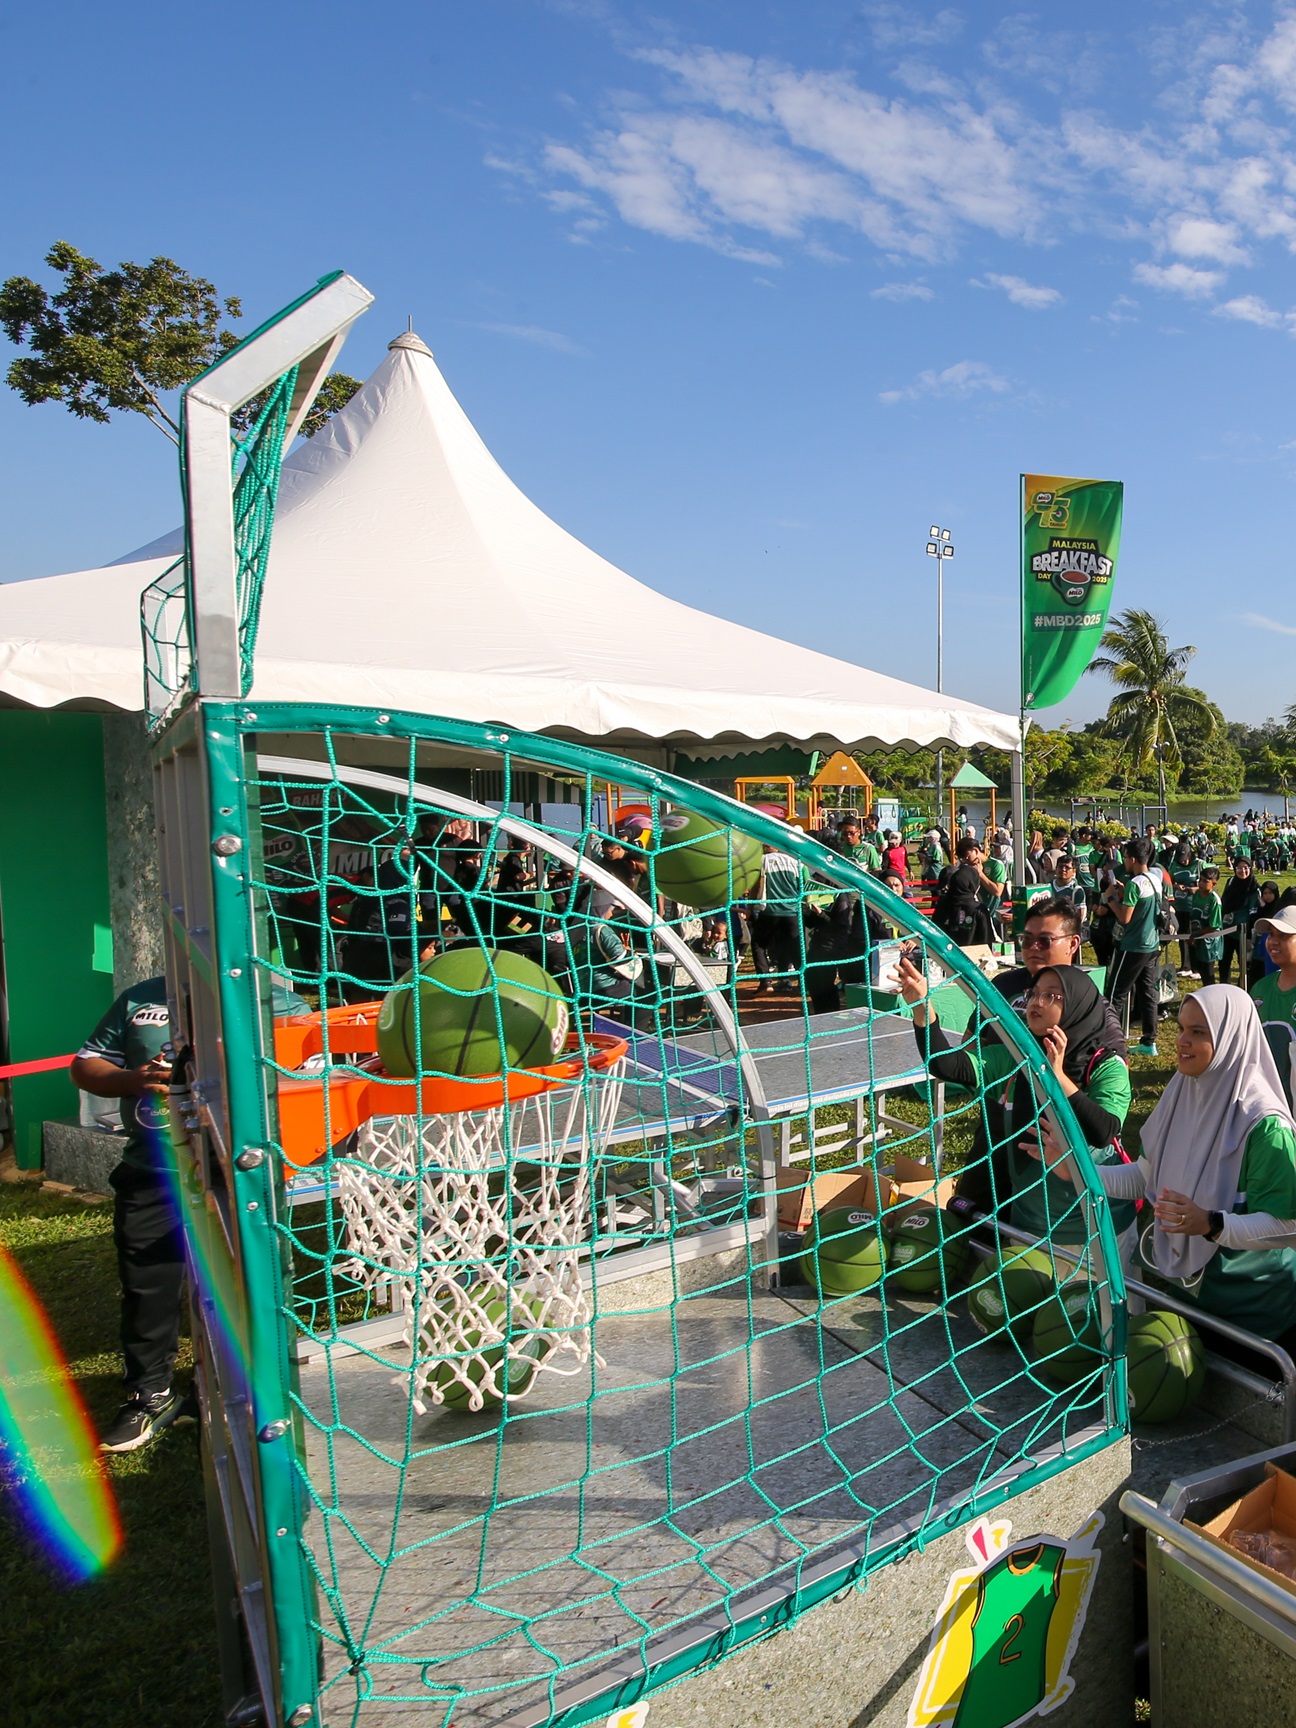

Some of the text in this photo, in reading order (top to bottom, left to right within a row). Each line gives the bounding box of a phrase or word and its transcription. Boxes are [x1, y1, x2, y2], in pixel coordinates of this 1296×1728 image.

[1052, 540, 1097, 551] MALAYSIA
[1032, 550, 1113, 576] BREAKFAST
[1091, 576, 1107, 584] 2025
[1034, 613, 1102, 627] #MBD2025
[135, 1012, 169, 1021] MILO
[904, 1217, 926, 1226] MILO
[1000, 1613, 1024, 1665] 2
